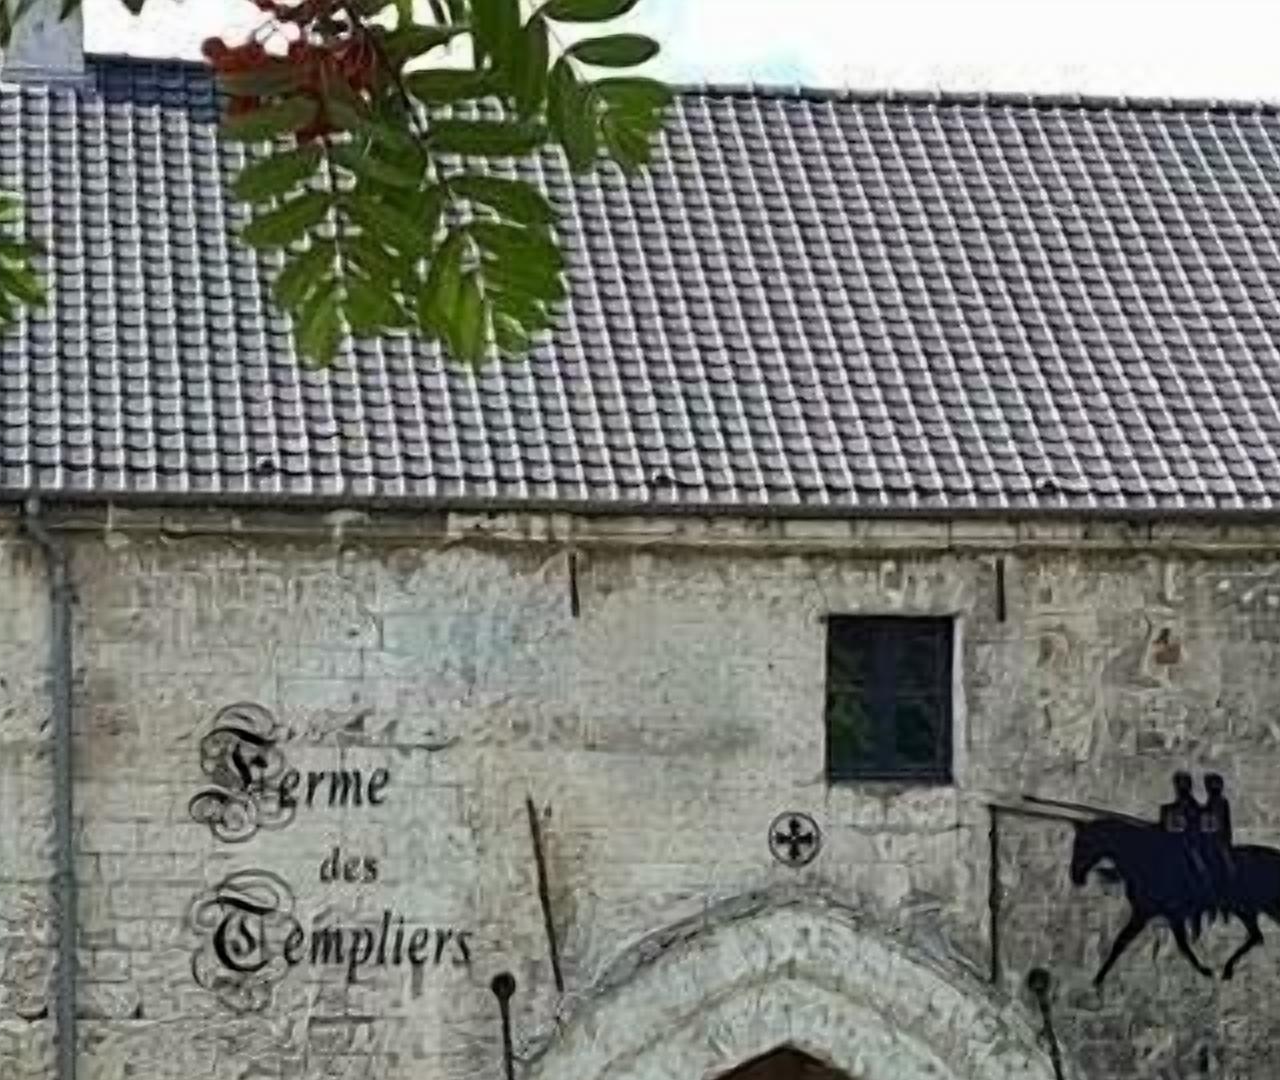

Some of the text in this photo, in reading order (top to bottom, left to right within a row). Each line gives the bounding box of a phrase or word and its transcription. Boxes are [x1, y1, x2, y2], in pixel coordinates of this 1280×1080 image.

[189, 702, 390, 843] Ferme
[320, 847, 378, 883] des
[190, 869, 472, 988] Templiers
